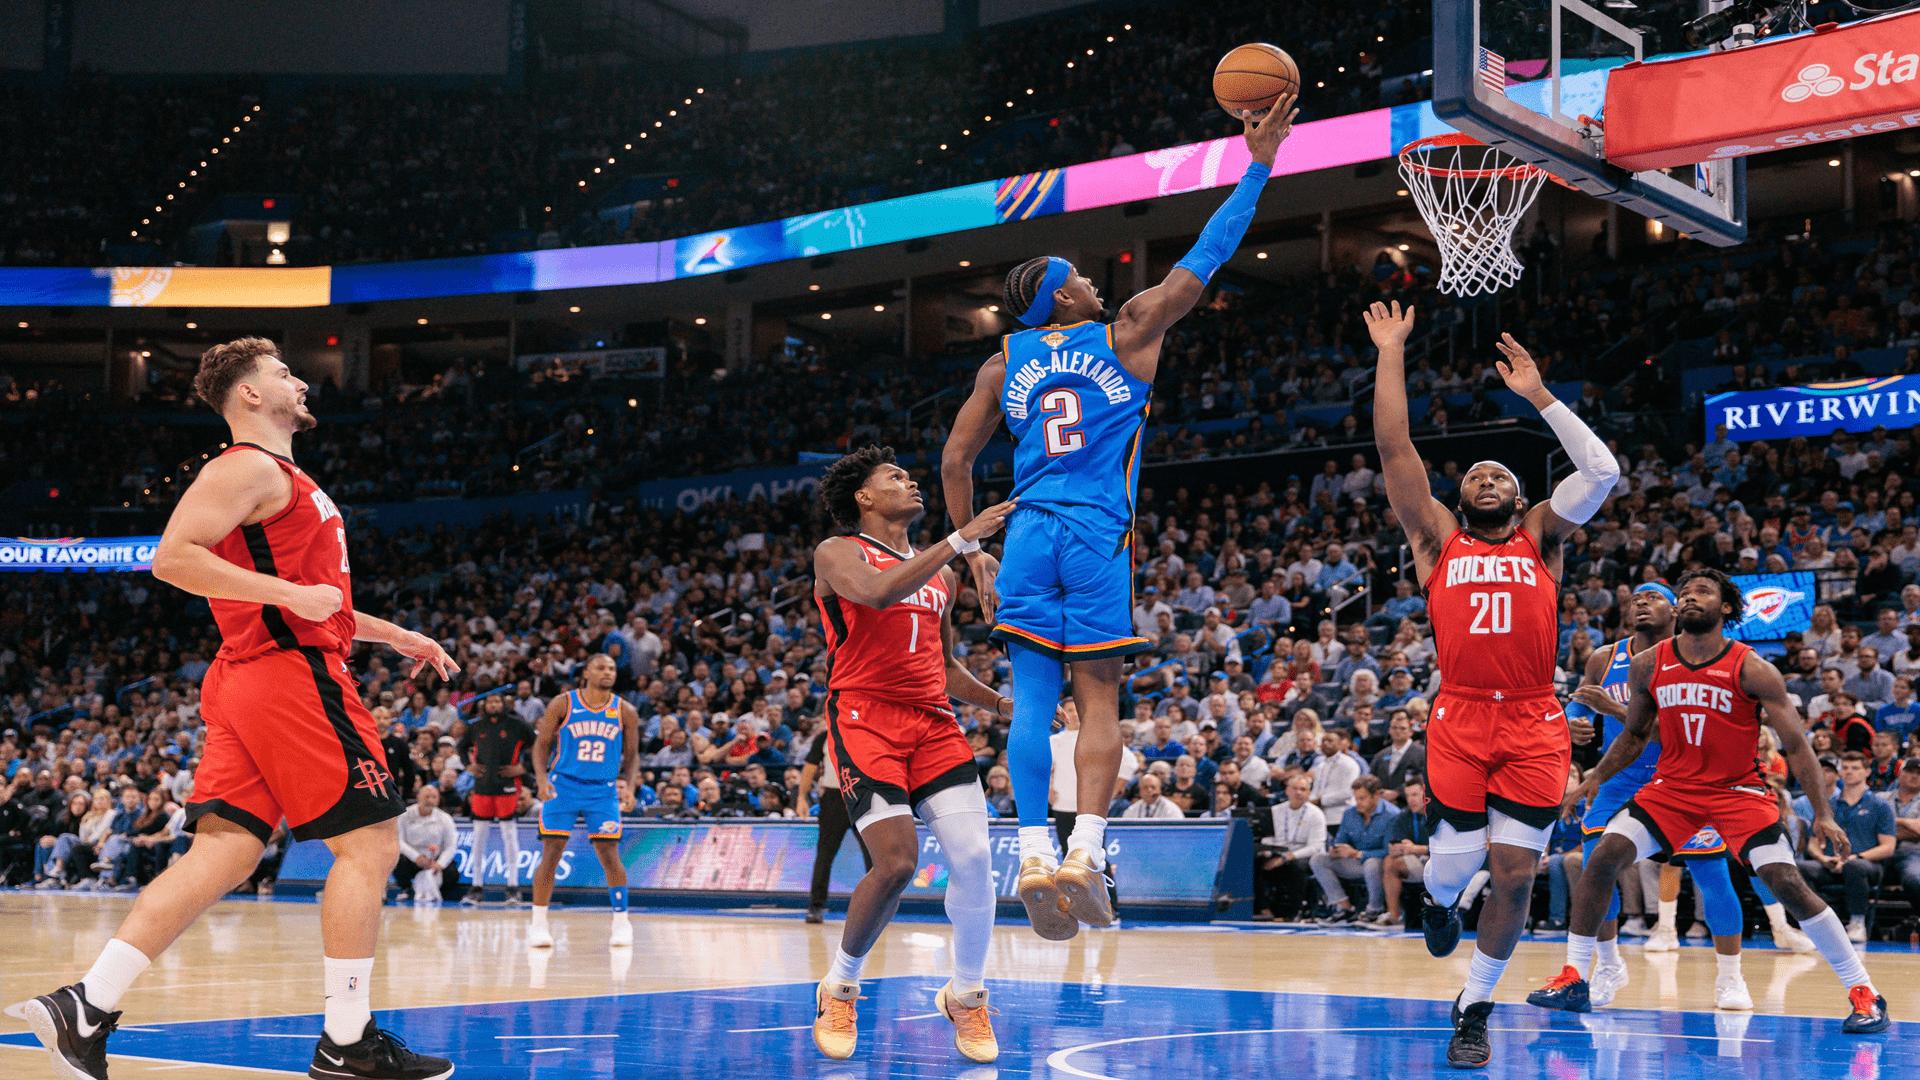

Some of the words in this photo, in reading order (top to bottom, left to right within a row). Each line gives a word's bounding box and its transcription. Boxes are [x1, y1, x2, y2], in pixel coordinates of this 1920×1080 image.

[1775, 121, 1900, 146] State
[1006, 351, 1131, 419] GILGEOUS-ALEXANDER
[1040, 388, 1085, 457] 2
[46, 547, 133, 563] FAVORITE
[1446, 555, 1537, 588] ROCKETS
[1470, 592, 1511, 634] 20
[909, 613, 918, 652] 1
[1655, 683, 1733, 713] ROCKETS
[567, 720, 620, 741] THUNDER
[1680, 713, 1706, 746] 17
[577, 740, 606, 762] 22
[453, 849, 575, 880] OLYMPIS
